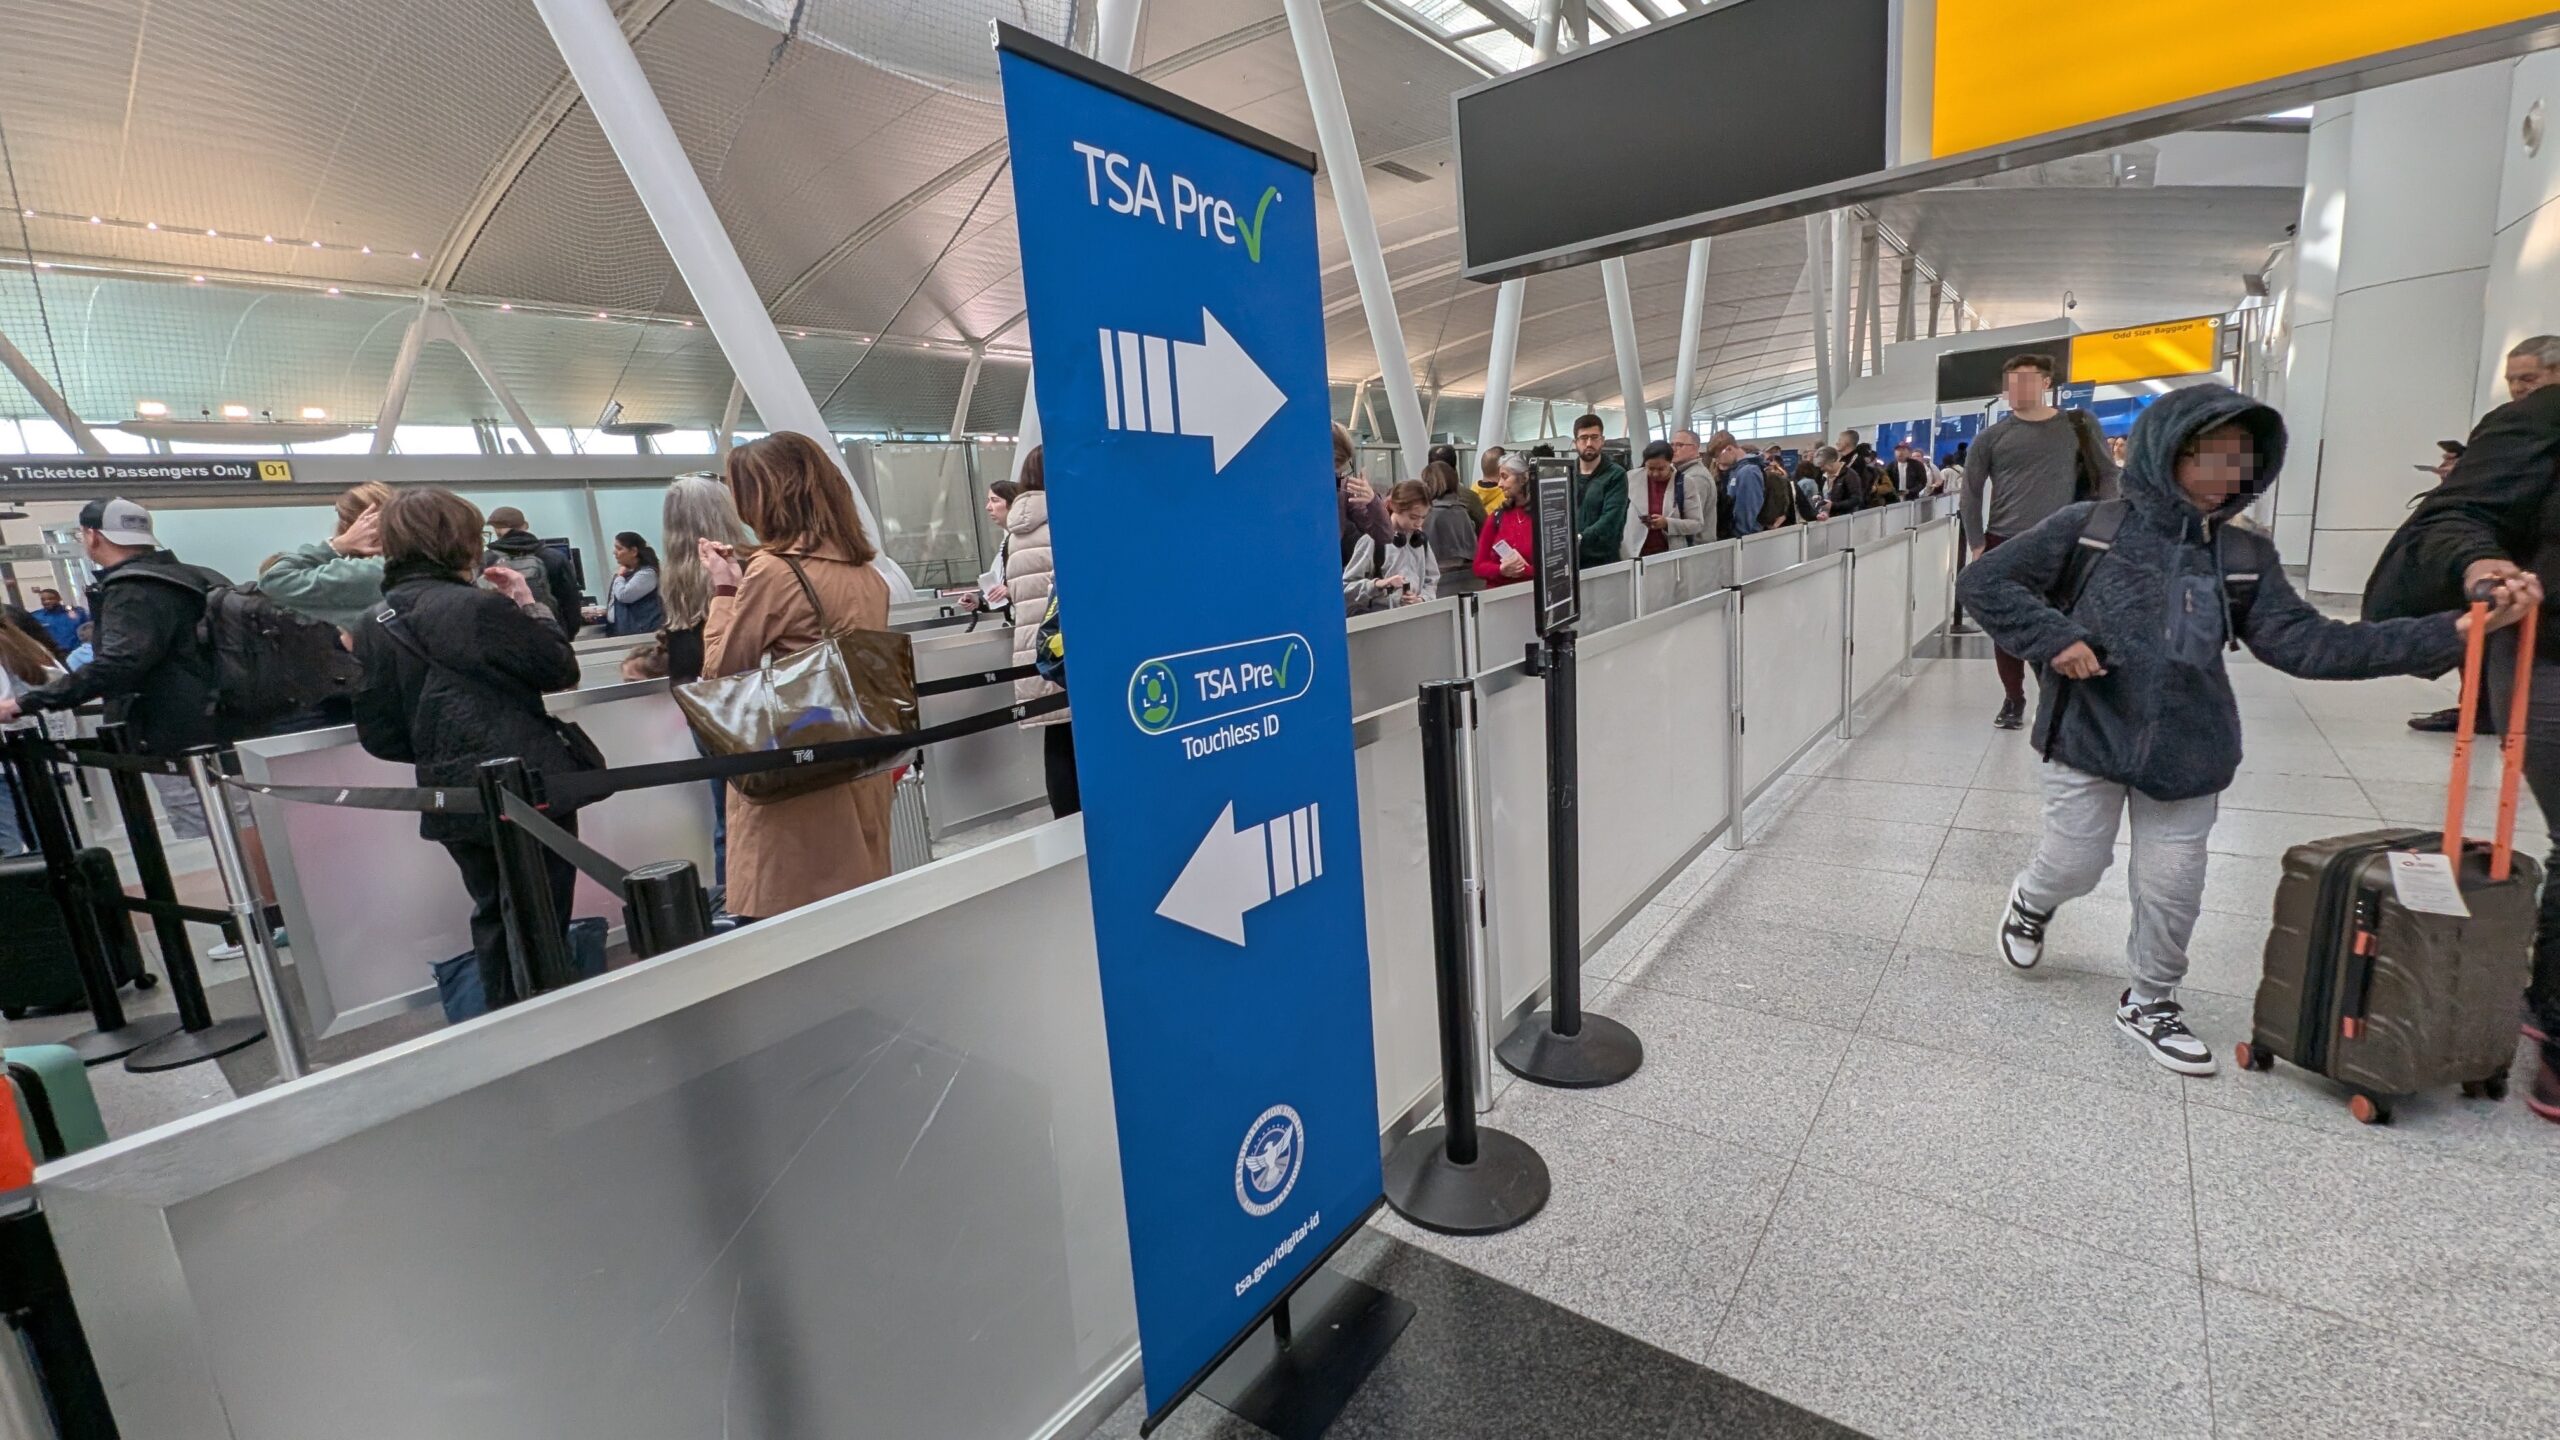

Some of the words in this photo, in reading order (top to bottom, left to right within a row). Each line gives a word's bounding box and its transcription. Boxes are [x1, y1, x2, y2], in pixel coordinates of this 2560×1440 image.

[1073, 140, 1166, 225] TSA
[1172, 174, 1236, 245] Pre
[2112, 330, 2132, 340] Odd
[2134, 328, 2152, 337] Size
[2154, 323, 2193, 335] Baggage
[12, 466, 99, 479] Ticketed
[103, 465, 209, 479] Passengers
[213, 464, 251, 478] Only
[1194, 667, 1238, 701] TSA
[1240, 663, 1273, 692] Pre
[792, 749, 815, 763] T4
[1182, 722, 1260, 760] Touchless
[1263, 714, 1280, 737] ID
[1234, 1210, 1320, 1297] tsa.gov/digital-id
